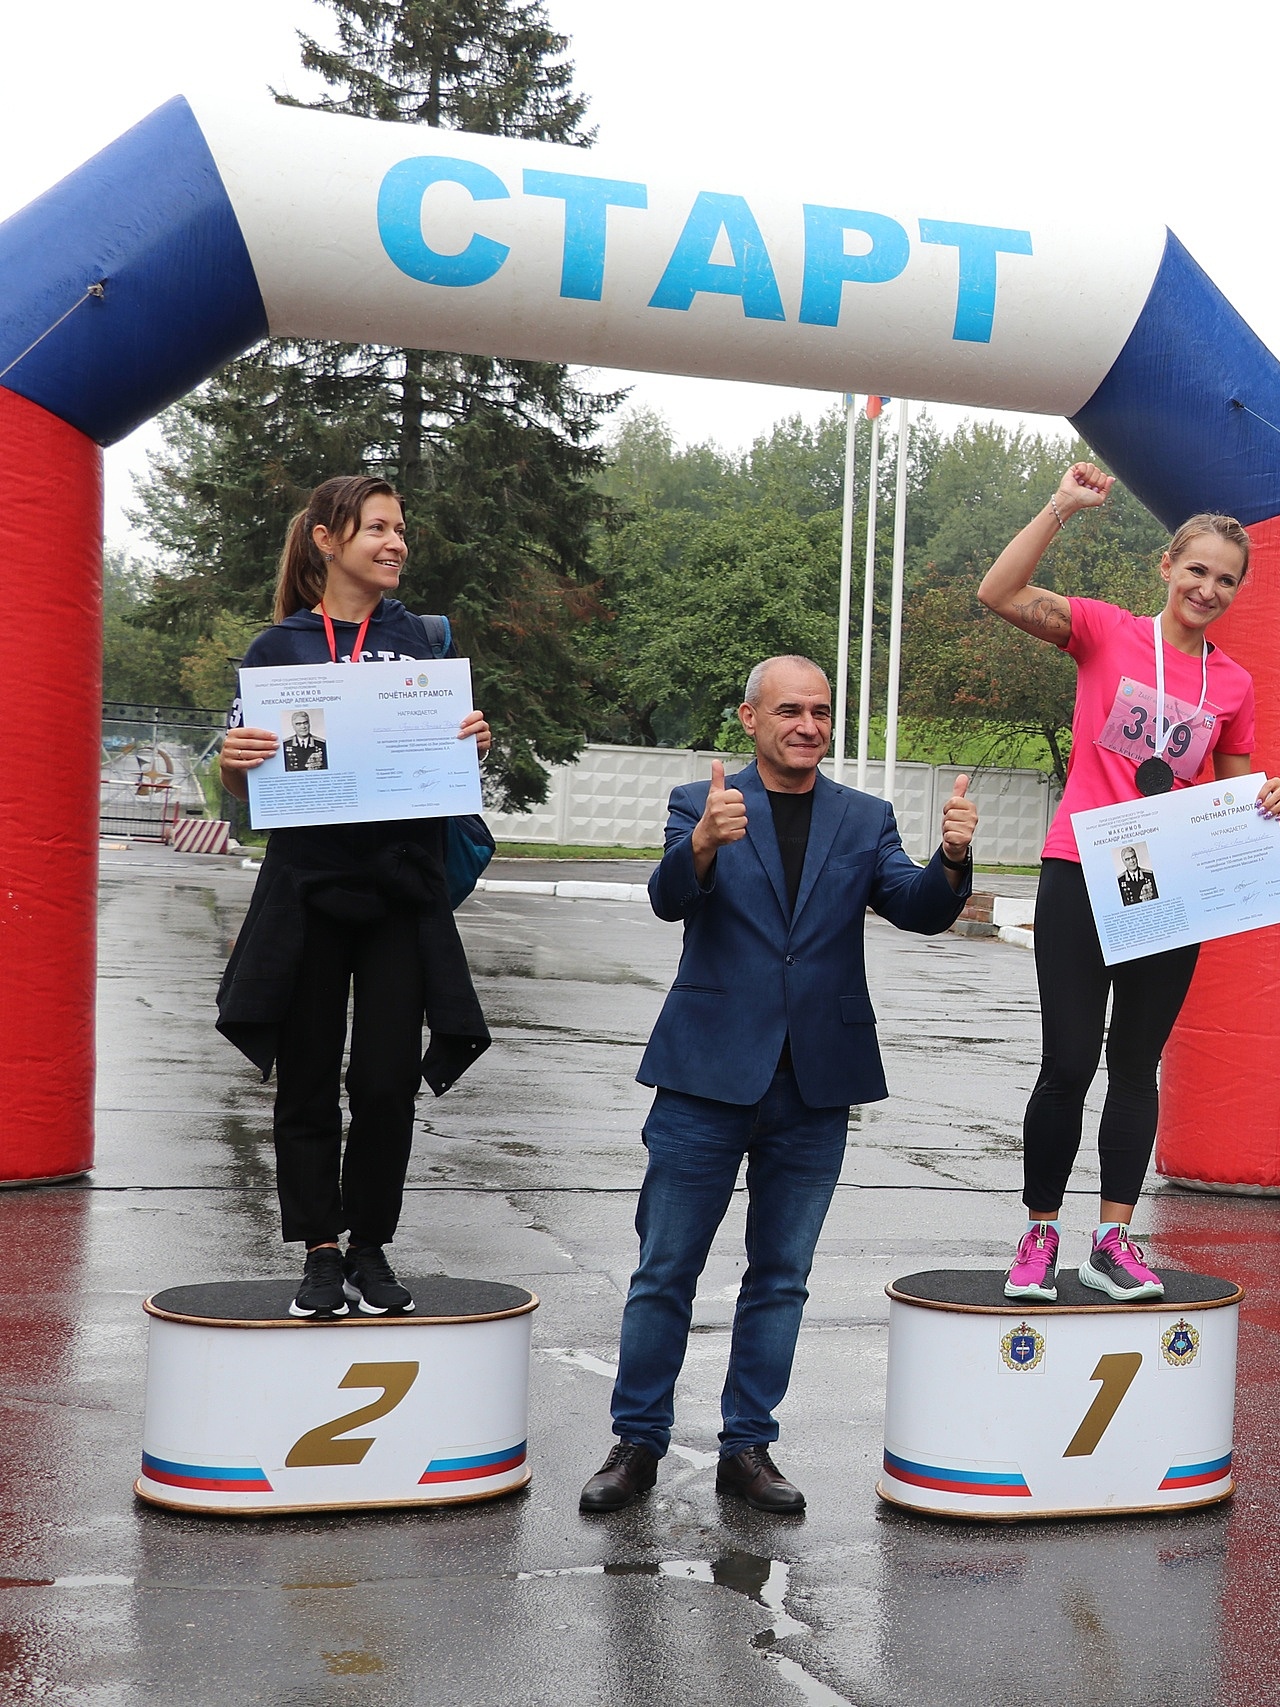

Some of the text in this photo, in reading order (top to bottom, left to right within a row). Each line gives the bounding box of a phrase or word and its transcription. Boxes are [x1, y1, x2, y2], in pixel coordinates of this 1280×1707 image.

[377, 156, 1033, 344] СТАРТ
[379, 689, 453, 700] ПОЧЁТНАЯ ГРАМОТА
[397, 709, 438, 717] НАГРАЖДАЕТСЯ
[1190, 803, 1258, 824] ПОЧЁТНАЯ ГРАМОТА
[1093, 827, 1160, 846] АЛЕКСАНДР АЛЕКСАНДРОВИЧ
[1108, 824, 1142, 835] МАКСИМОВ
[1210, 824, 1248, 837] НАГРАЖДАЕТСЯ
[285, 1361, 419, 1467] 2
[1062, 1352, 1143, 1458] 1
